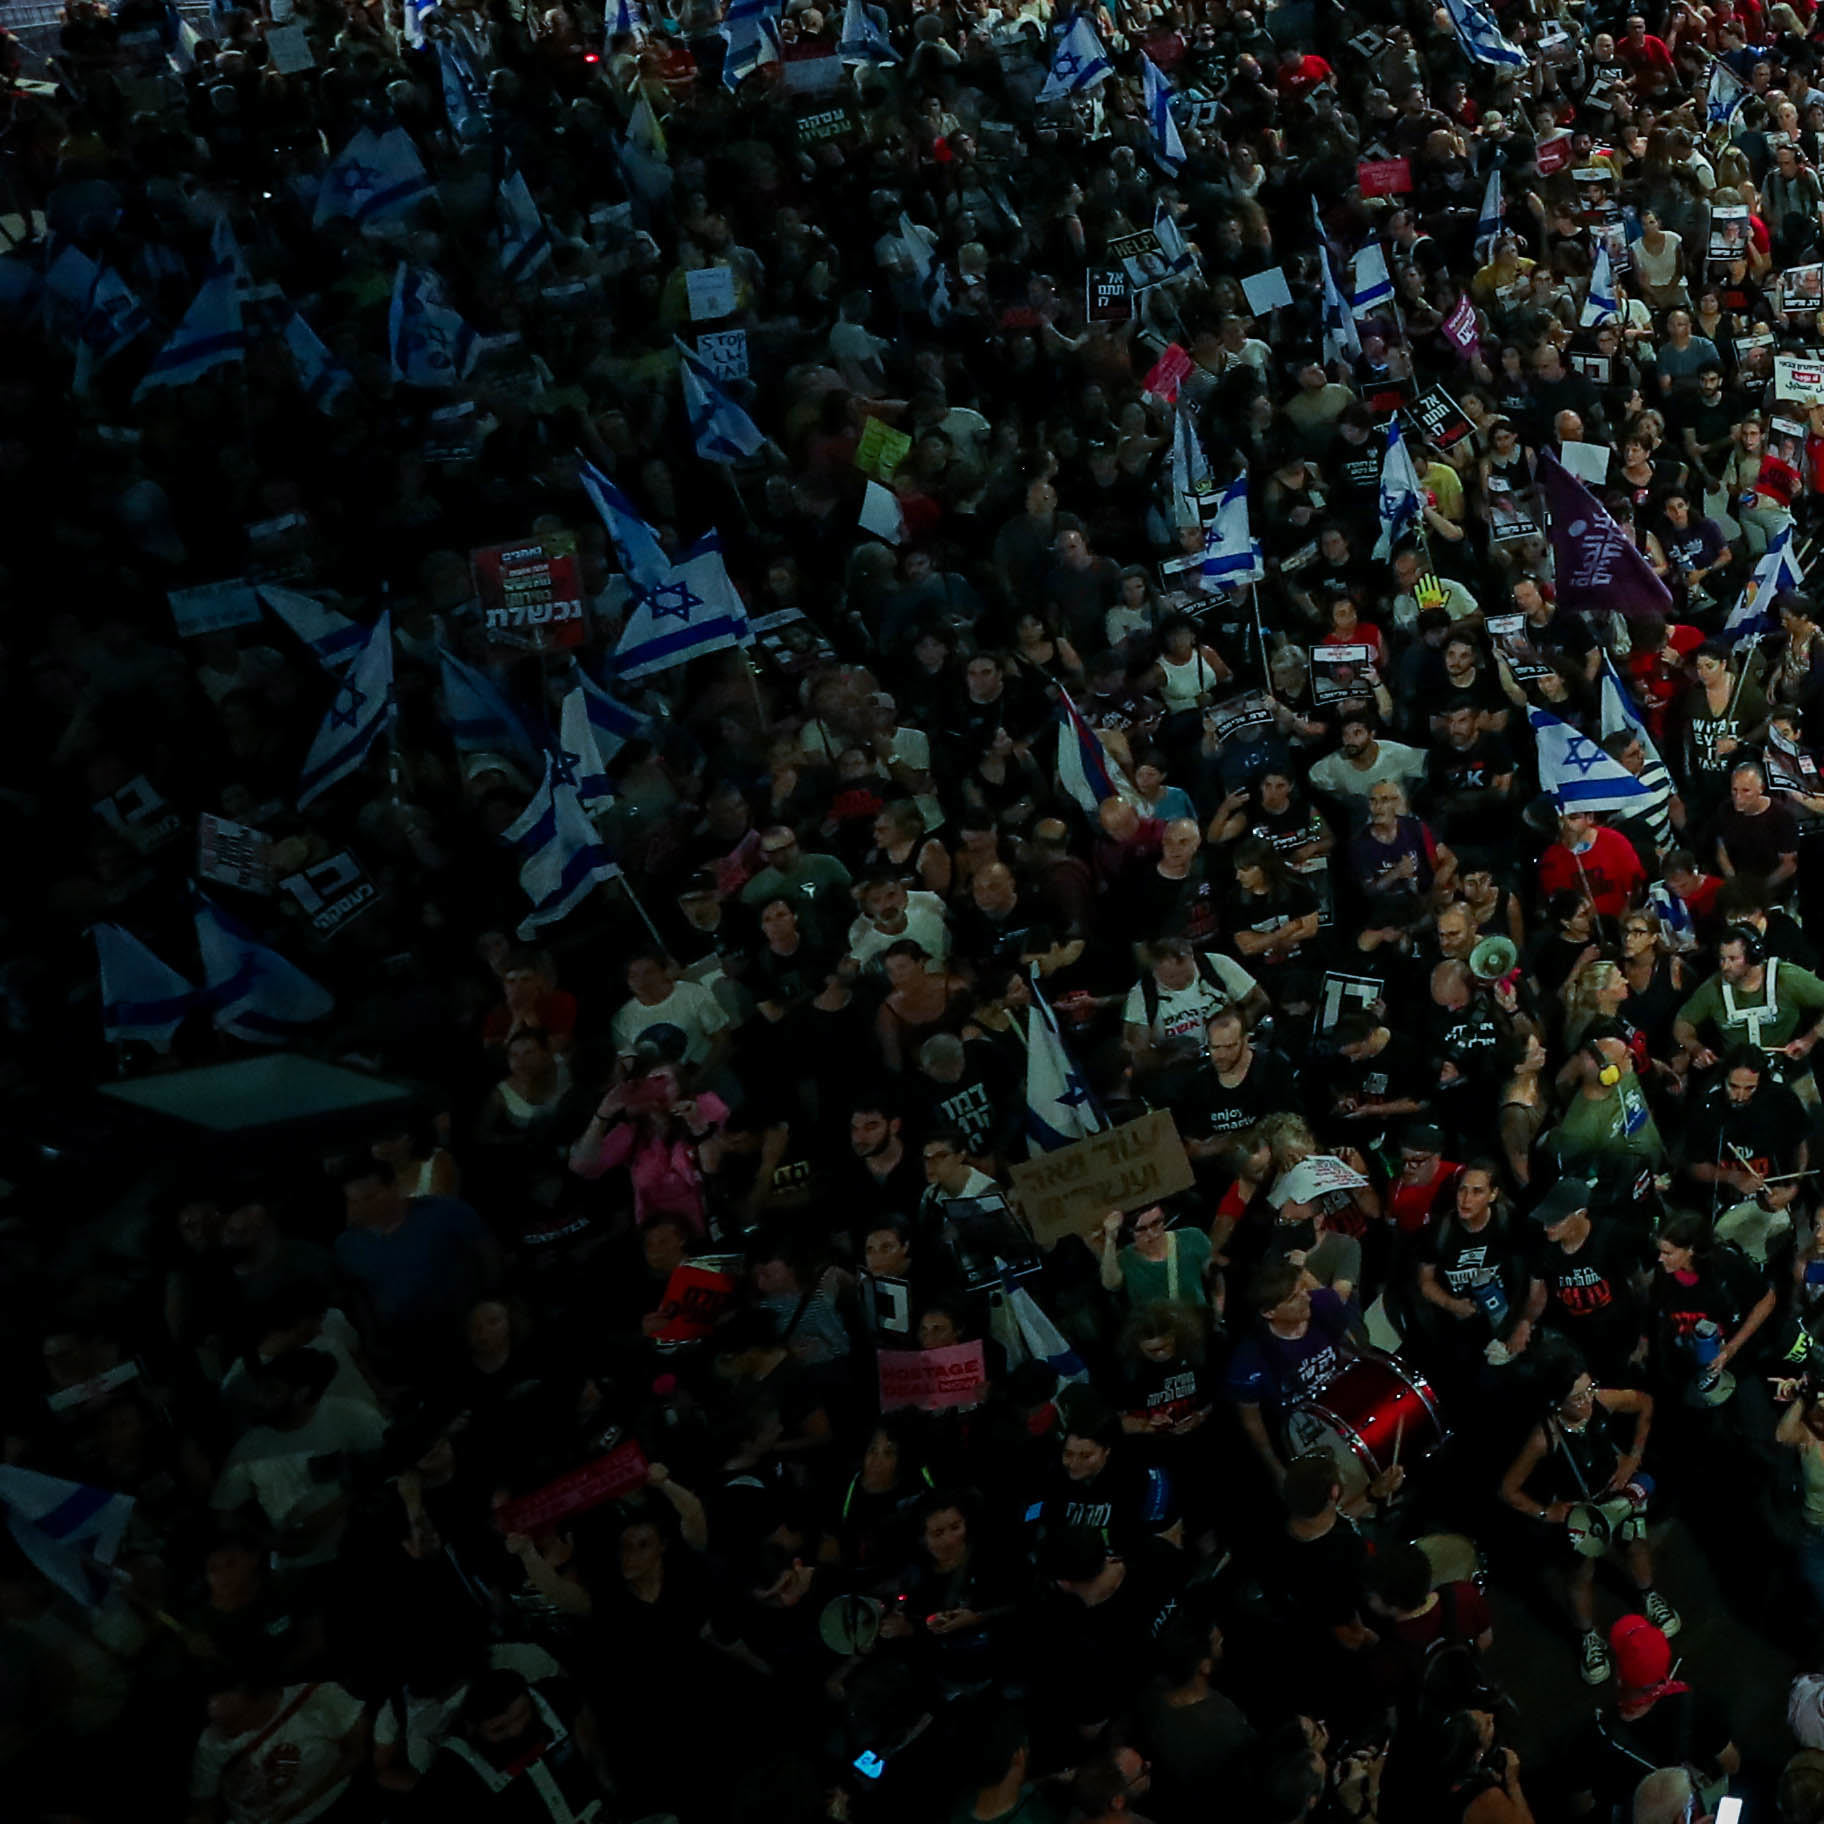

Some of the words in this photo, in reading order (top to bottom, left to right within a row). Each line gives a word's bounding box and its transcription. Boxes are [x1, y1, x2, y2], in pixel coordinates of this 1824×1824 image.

[796, 108, 844, 130] עסקה
[485, 600, 582, 628] נכשלת
[1692, 719, 1739, 735] WHAT
[279, 851, 361, 915] כן
[313, 883, 375, 929] לעסקה
[884, 1359, 979, 1379] HOSTAGE
[885, 1385, 932, 1394] DEAL
[939, 1380, 978, 1392] NOW
